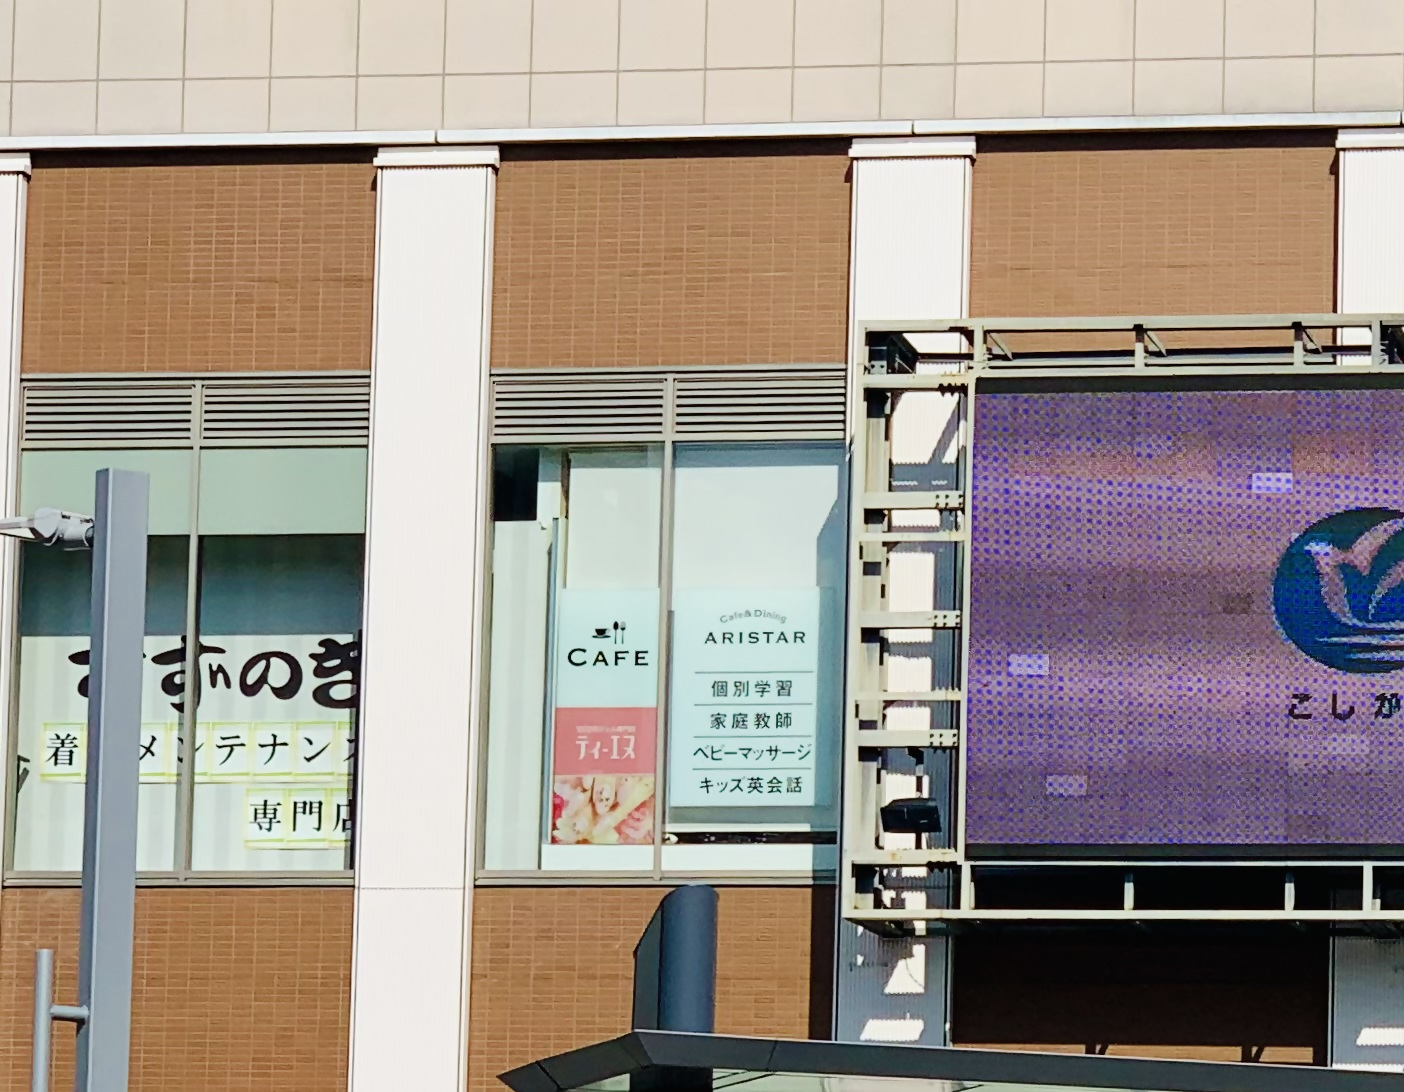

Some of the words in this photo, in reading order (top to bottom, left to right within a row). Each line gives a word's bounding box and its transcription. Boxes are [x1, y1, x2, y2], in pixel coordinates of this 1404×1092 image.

[704, 631, 806, 644] ARISTAR
[568, 648, 650, 667] CAFE
[711, 680, 793, 698] 個別学習
[710, 712, 792, 729] 家庭教師
[693, 743, 813, 762] ベビーマッサージ
[699, 776, 803, 794] キッズ英会話
